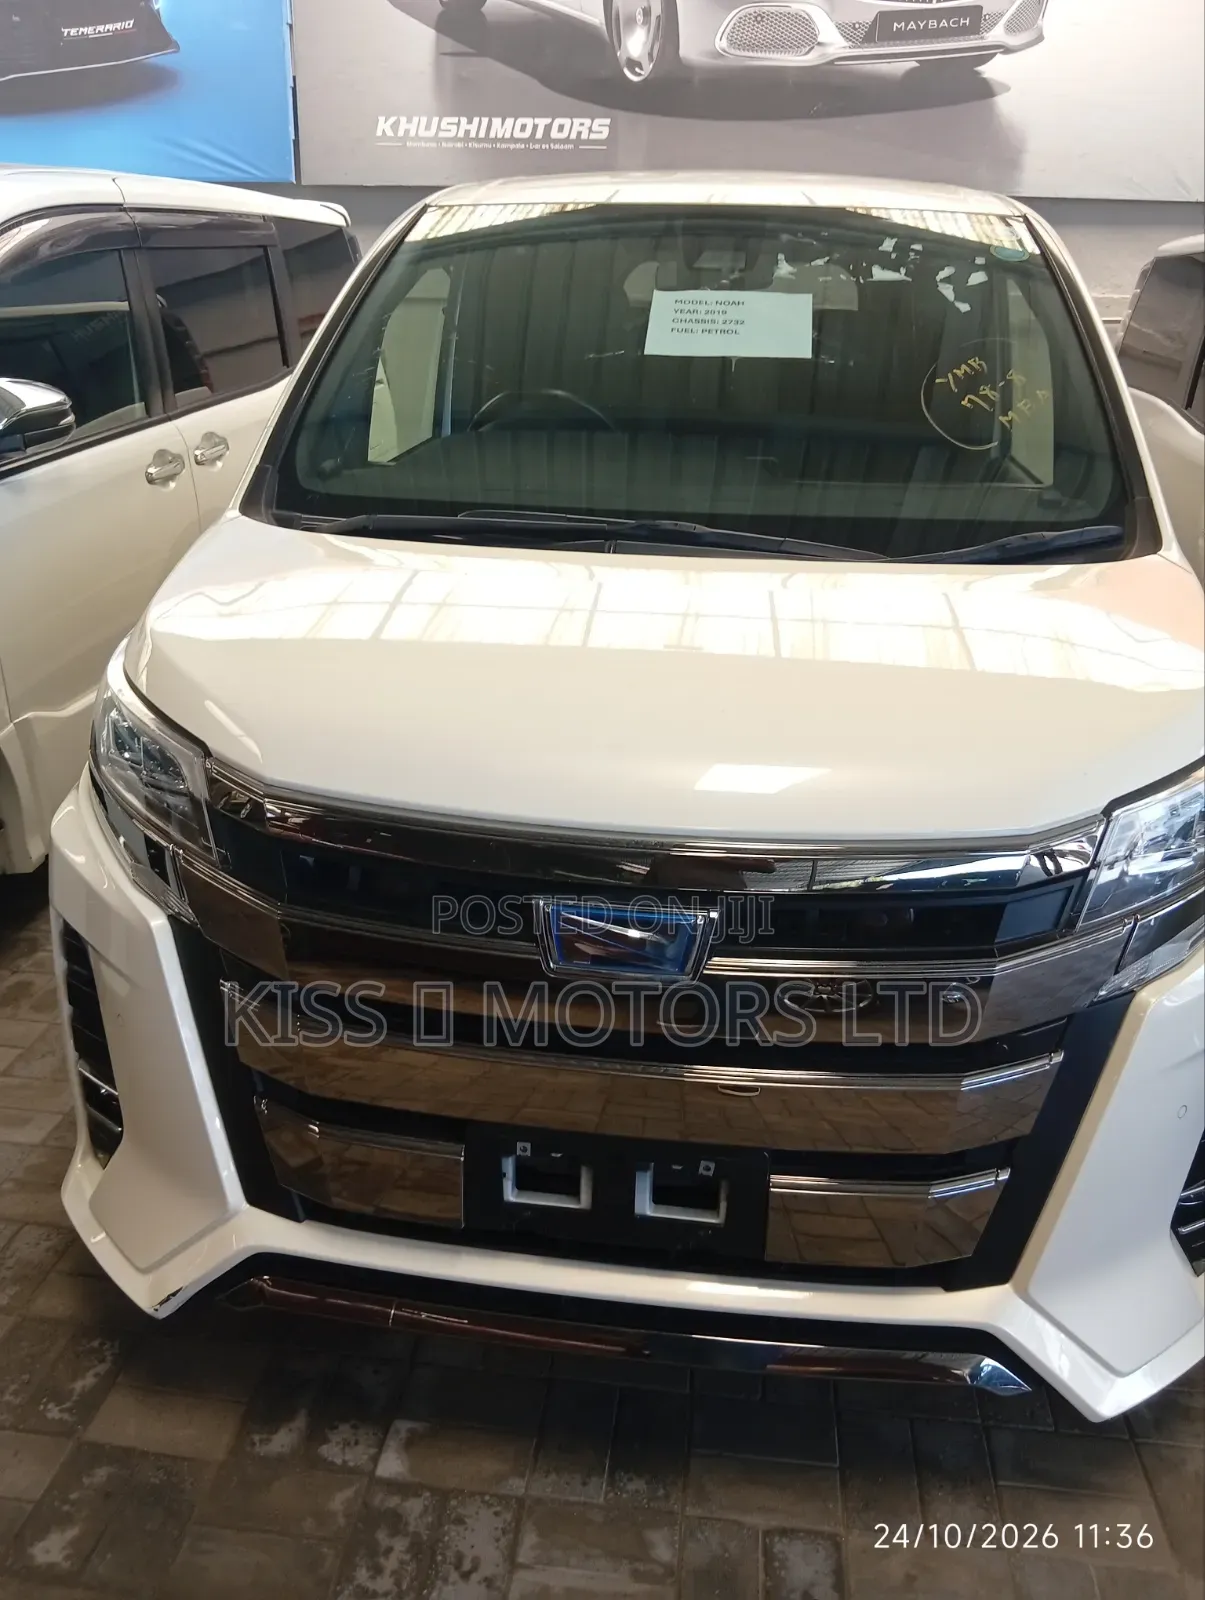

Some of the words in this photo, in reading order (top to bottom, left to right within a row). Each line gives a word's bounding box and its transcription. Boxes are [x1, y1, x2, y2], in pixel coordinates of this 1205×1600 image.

[61, 18, 135, 37] TEMERARIO
[892, 17, 970, 32] MAYBACH
[671, 317, 719, 325] CHASSIS:
